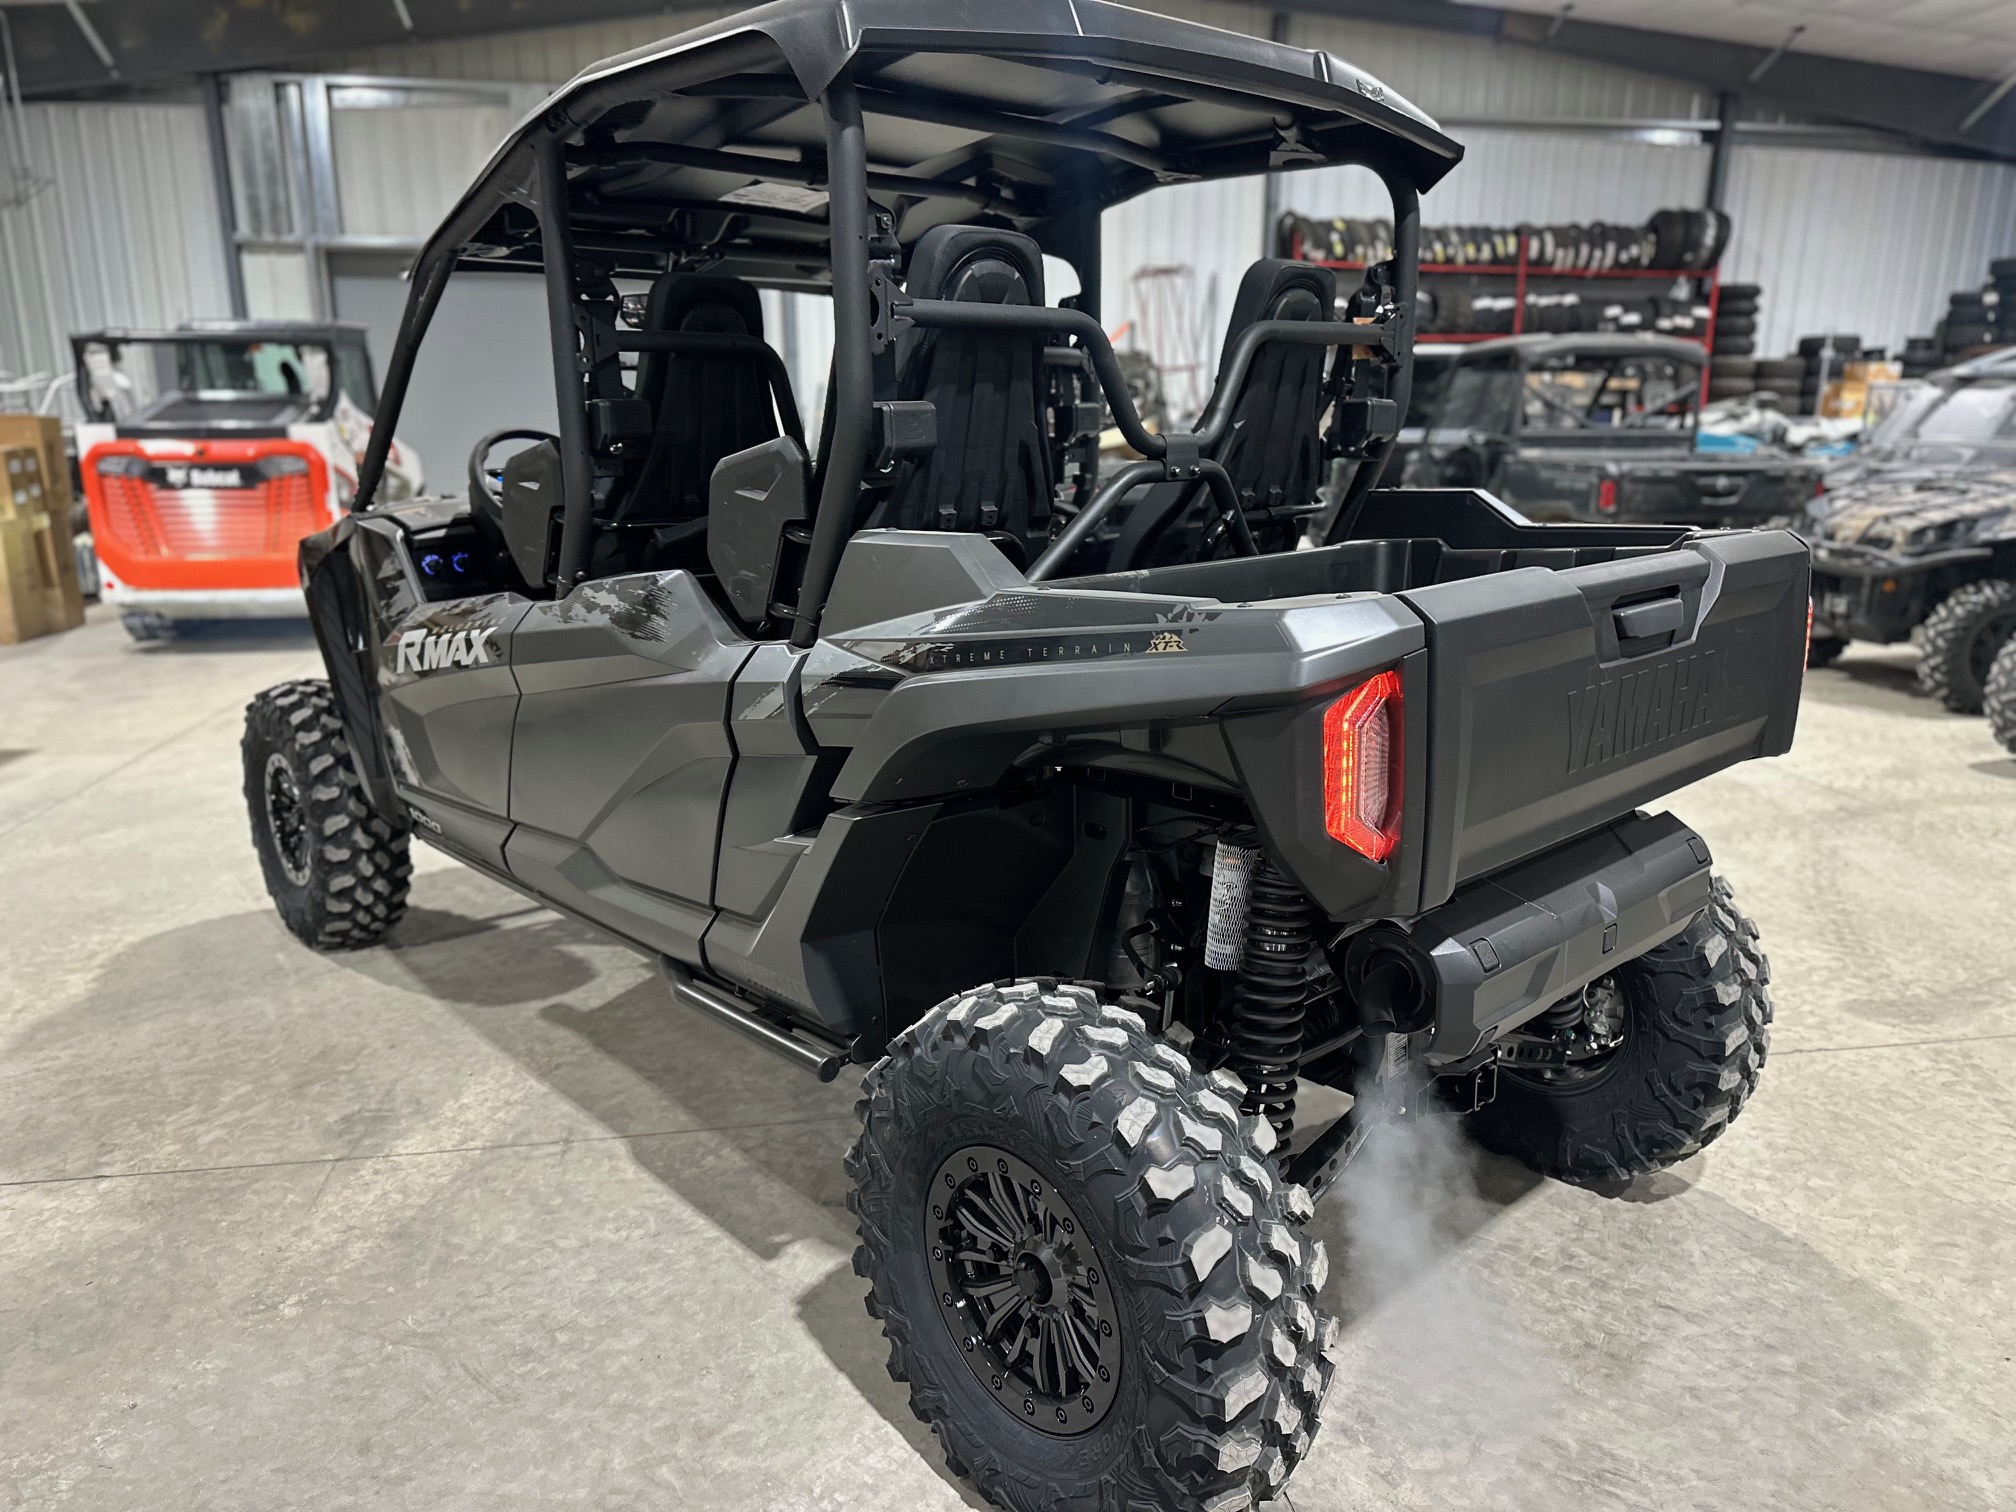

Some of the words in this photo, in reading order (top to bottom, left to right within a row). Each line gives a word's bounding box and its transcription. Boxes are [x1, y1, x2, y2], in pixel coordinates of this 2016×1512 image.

[189, 467, 241, 488] Bobcat
[397, 626, 498, 674] RMAX
[929, 649, 1005, 665] XTREME
[1026, 642, 1131, 658] TERRAIN
[1567, 650, 1716, 775] YAMAHA
[409, 807, 442, 834] 1000
